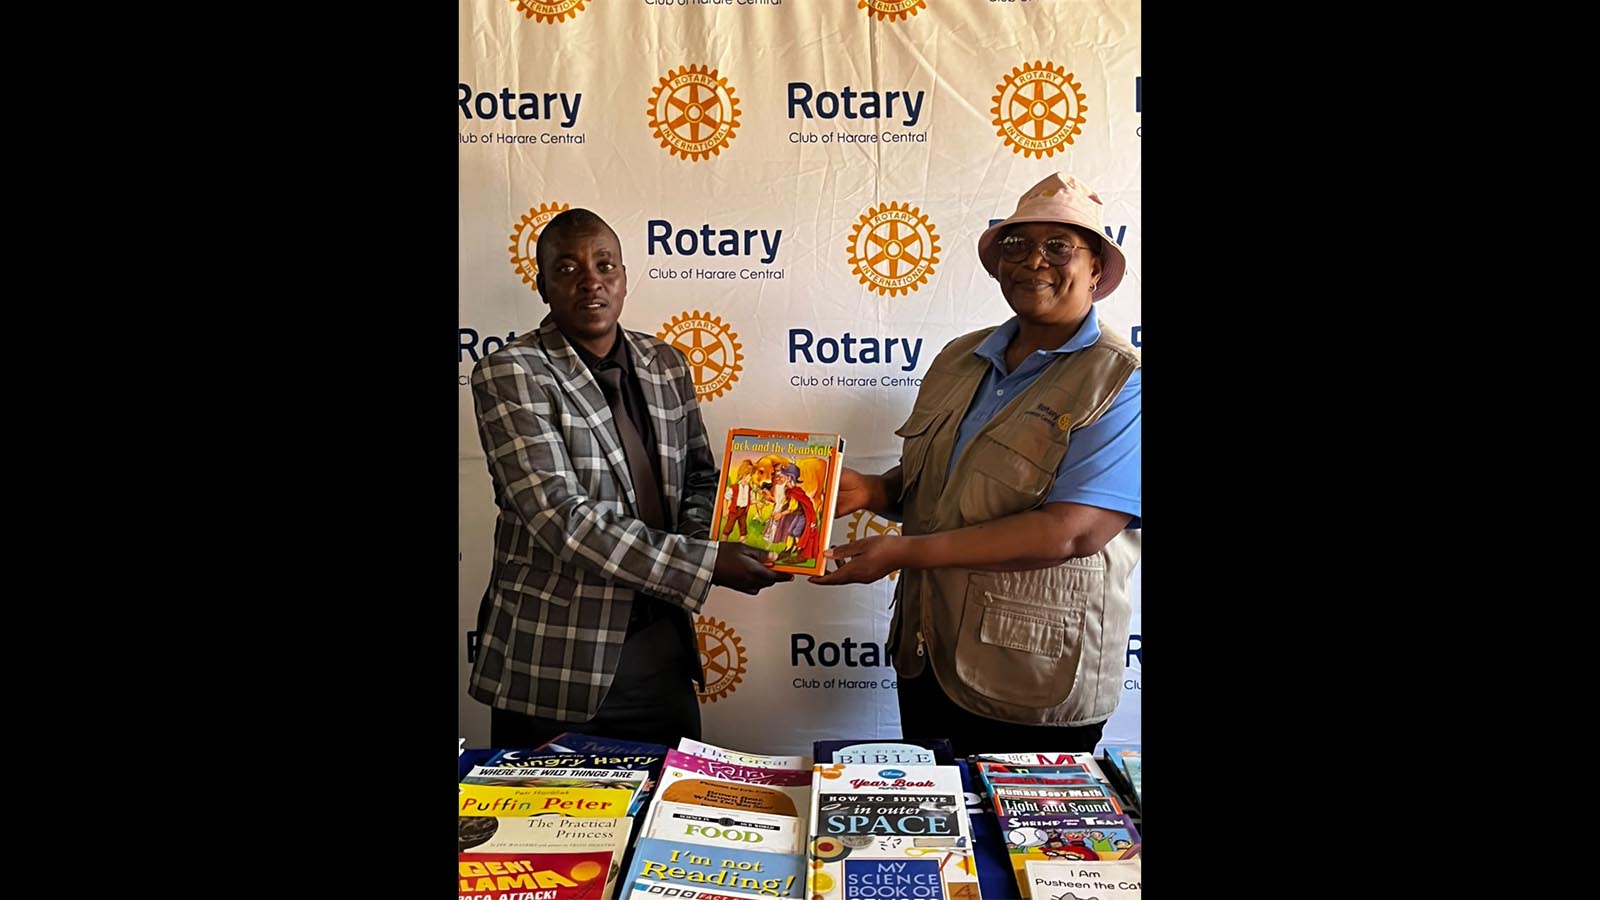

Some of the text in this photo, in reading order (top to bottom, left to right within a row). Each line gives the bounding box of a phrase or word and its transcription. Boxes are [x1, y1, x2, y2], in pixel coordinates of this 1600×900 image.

[674, 74, 713, 86] ROTARY
[1019, 71, 1058, 83] ROTARY
[459, 83, 582, 128] Rotary
[788, 82, 924, 127] Rotary
[459, 132, 586, 144] lub of Harare Central
[662, 126, 729, 152] INTERNATIONAL
[789, 131, 927, 144] Club of Harare Central
[1006, 123, 1074, 150] INTERNATIONAL
[875, 212, 914, 223] ROTARY
[647, 219, 782, 264] Rotary
[649, 268, 785, 280] Club of Harare Central
[862, 263, 927, 288] INTERNATIONAL
[678, 321, 715, 331] ROTARY
[789, 328, 923, 371] Rotary
[697, 371, 731, 393] ATIONAL
[790, 376, 923, 387] Club of Harare Centra
[752, 441, 770, 452] and
[772, 442, 785, 453] the
[788, 443, 832, 457] Beanstalk
[697, 625, 719, 634] TARY
[793, 678, 820, 689] Club
[823, 678, 835, 689] of
[839, 679, 877, 689] Harare
[594, 756, 659, 765] Harry
[840, 754, 931, 765] BIBLE
[479, 768, 517, 776] WHERE
[519, 768, 539, 776] THE
[570, 770, 609, 778] THINGS
[708, 761, 775, 780] Fairy
[850, 779, 888, 789] Year
[891, 779, 936, 788] Book
[997, 788, 1036, 797] Human
[1068, 789, 1103, 797] Math
[461, 797, 613, 811] Puffin Peter
[854, 804, 922, 815] in outer
[1005, 800, 1112, 814] Light and Sound
[528, 818, 617, 828] The Practical
[827, 815, 950, 834] SPACE
[1080, 817, 1124, 825] TEAM
[556, 830, 614, 839] Princess
[684, 824, 764, 843] FOOD
[670, 850, 764, 872] I'm not
[878, 862, 907, 872] MY
[459, 860, 534, 877] GENT
[1079, 869, 1101, 878] Am
[459, 870, 578, 892] LAMA
[640, 860, 796, 898] Reading!
[848, 874, 939, 885] SCIENCE
[1035, 878, 1090, 889] Pusheen
[1094, 881, 1115, 890] the
[498, 890, 557, 900] ATTACK!
[849, 886, 940, 897] BOOK OF
